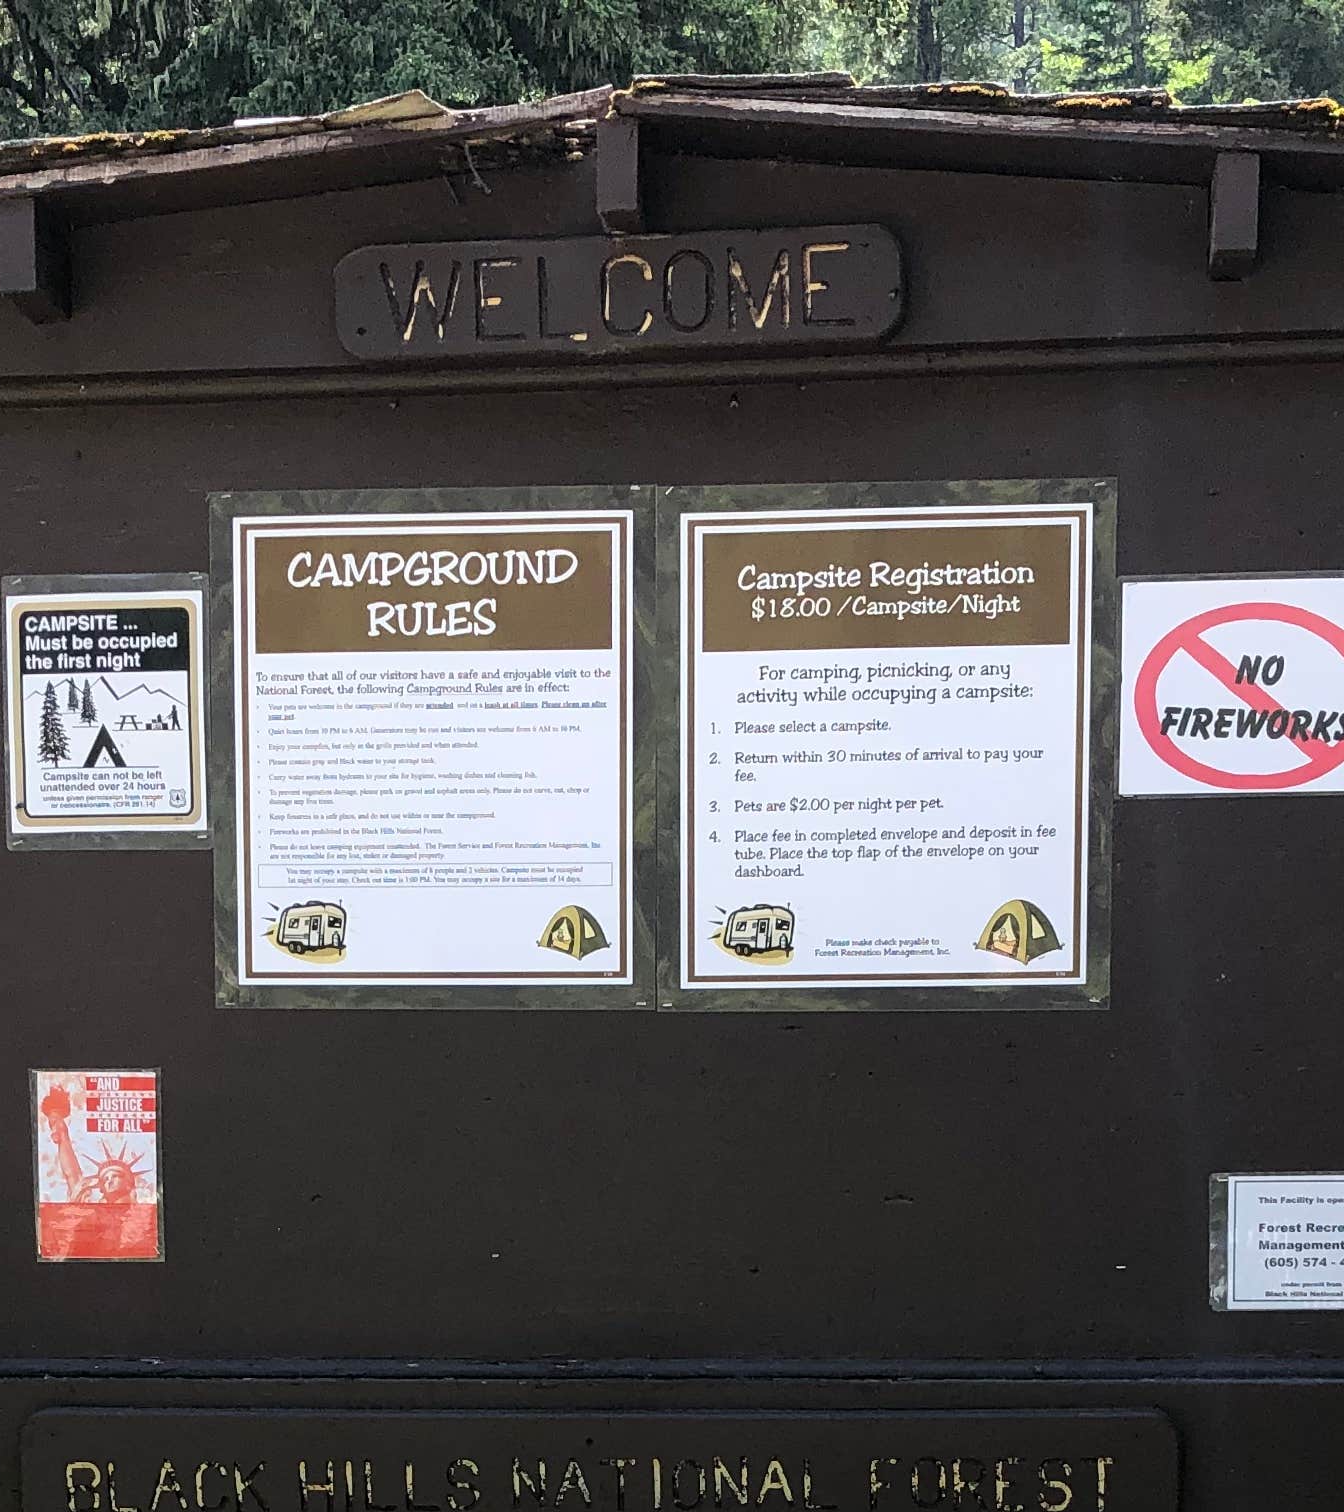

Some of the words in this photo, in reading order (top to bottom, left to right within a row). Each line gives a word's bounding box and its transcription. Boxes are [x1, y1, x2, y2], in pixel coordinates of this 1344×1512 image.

[380, 240, 856, 344] WELCOME
[287, 548, 578, 588] CAMPGROUND
[737, 564, 861, 597] Campsite
[869, 560, 1034, 593] Registration
[366, 597, 497, 637] RULES
[751, 595, 831, 622] $18.00
[24, 614, 118, 632] CAMPSITE
[25, 635, 68, 651] Must
[71, 634, 94, 650] be
[97, 632, 178, 652] occupied
[24, 654, 53, 669] the
[56, 653, 92, 669] first
[95, 652, 141, 671] night
[1235, 655, 1285, 685] NO
[255, 671, 268, 682] To
[270, 673, 305, 681] ensure
[307, 671, 329, 681] that
[331, 670, 344, 680] all
[345, 669, 357, 680] of
[379, 670, 418, 680] visitors
[420, 669, 446, 679] have
[457, 668, 478, 679] safe
[480, 668, 500, 679] and
[502, 668, 552, 681] enjoyable
[554, 668, 577, 678] visit
[579, 669, 591, 678] to
[593, 667, 611, 678] the
[759, 665, 786, 680] For
[790, 667, 862, 683] camping,
[866, 661, 953, 682] picnicking,
[958, 665, 976, 676] or
[980, 664, 1011, 679] any
[255, 684, 298, 696] National
[336, 684, 354, 694] the
[356, 683, 404, 696] following
[406, 682, 472, 696] Campground
[474, 682, 503, 693] Rules
[505, 684, 523, 692] are
[524, 682, 535, 692] in
[537, 681, 570, 692] effect:
[736, 687, 798, 706] activity
[803, 686, 847, 701] while
[851, 688, 936, 704] occupying
[941, 687, 951, 699] a
[955, 683, 1033, 703] campsite:
[711, 722, 721, 734] 1.
[734, 721, 775, 734] Please
[778, 720, 816, 733] select
[819, 722, 827, 732] a
[830, 718, 891, 735] campsite.
[708, 752, 720, 764] 2.
[734, 751, 778, 764] Return
[782, 750, 823, 763] within
[827, 749, 847, 762] 30
[849, 749, 902, 762] minutes
[904, 747, 918, 760] of
[922, 747, 963, 760] arrival
[966, 748, 981, 759] to
[983, 750, 1009, 763] pay
[1012, 749, 1044, 762] your
[42, 771, 90, 782] Campsite
[112, 771, 129, 780] not
[131, 771, 144, 779] be
[146, 770, 162, 779] left
[734, 769, 756, 782] fee.
[39, 782, 96, 792] unattended
[97, 783, 120, 791] over
[122, 781, 134, 790] 24
[136, 781, 166, 790] hours
[708, 800, 721, 812] 3.
[734, 799, 763, 812] Pets
[765, 801, 786, 812] are
[789, 796, 830, 812] $2.00
[833, 800, 855, 814] per
[857, 797, 892, 814] night
[895, 799, 917, 813] per
[919, 798, 944, 812] pet.
[708, 830, 721, 843] 4.
[734, 830, 768, 842] Place
[771, 828, 791, 842] fee
[794, 829, 807, 841] in
[810, 827, 877, 844] completed
[880, 827, 938, 843] envelope
[941, 826, 966, 839] and
[968, 825, 1017, 842] deposit
[1020, 828, 1033, 837] in
[1036, 824, 1057, 837] fee
[734, 847, 766, 860] tube.
[769, 847, 803, 860] Place
[806, 846, 828, 859] the
[831, 847, 853, 862] top
[856, 845, 881, 861] flap
[884, 844, 898, 857] of
[901, 845, 923, 857] the
[926, 844, 985, 860] envelope
[987, 847, 1005, 856] on
[1008, 846, 1040, 859] your
[734, 863, 804, 877] dashboard.
[97, 1098, 143, 1111] JUSTICE
[97, 1119, 118, 1132] FOR
[1258, 1196, 1278, 1204] This
[1279, 1196, 1314, 1205] Facility
[1258, 1223, 1302, 1232] Forest
[1264, 1257, 1299, 1269] (605)
[1302, 1257, 1327, 1267] 574
[65, 1460, 269, 1512] BLACK
[296, 1458, 481, 1512] HILLS
[512, 1456, 838, 1510] NATIONAL
[869, 1455, 1114, 1512] FOREST
